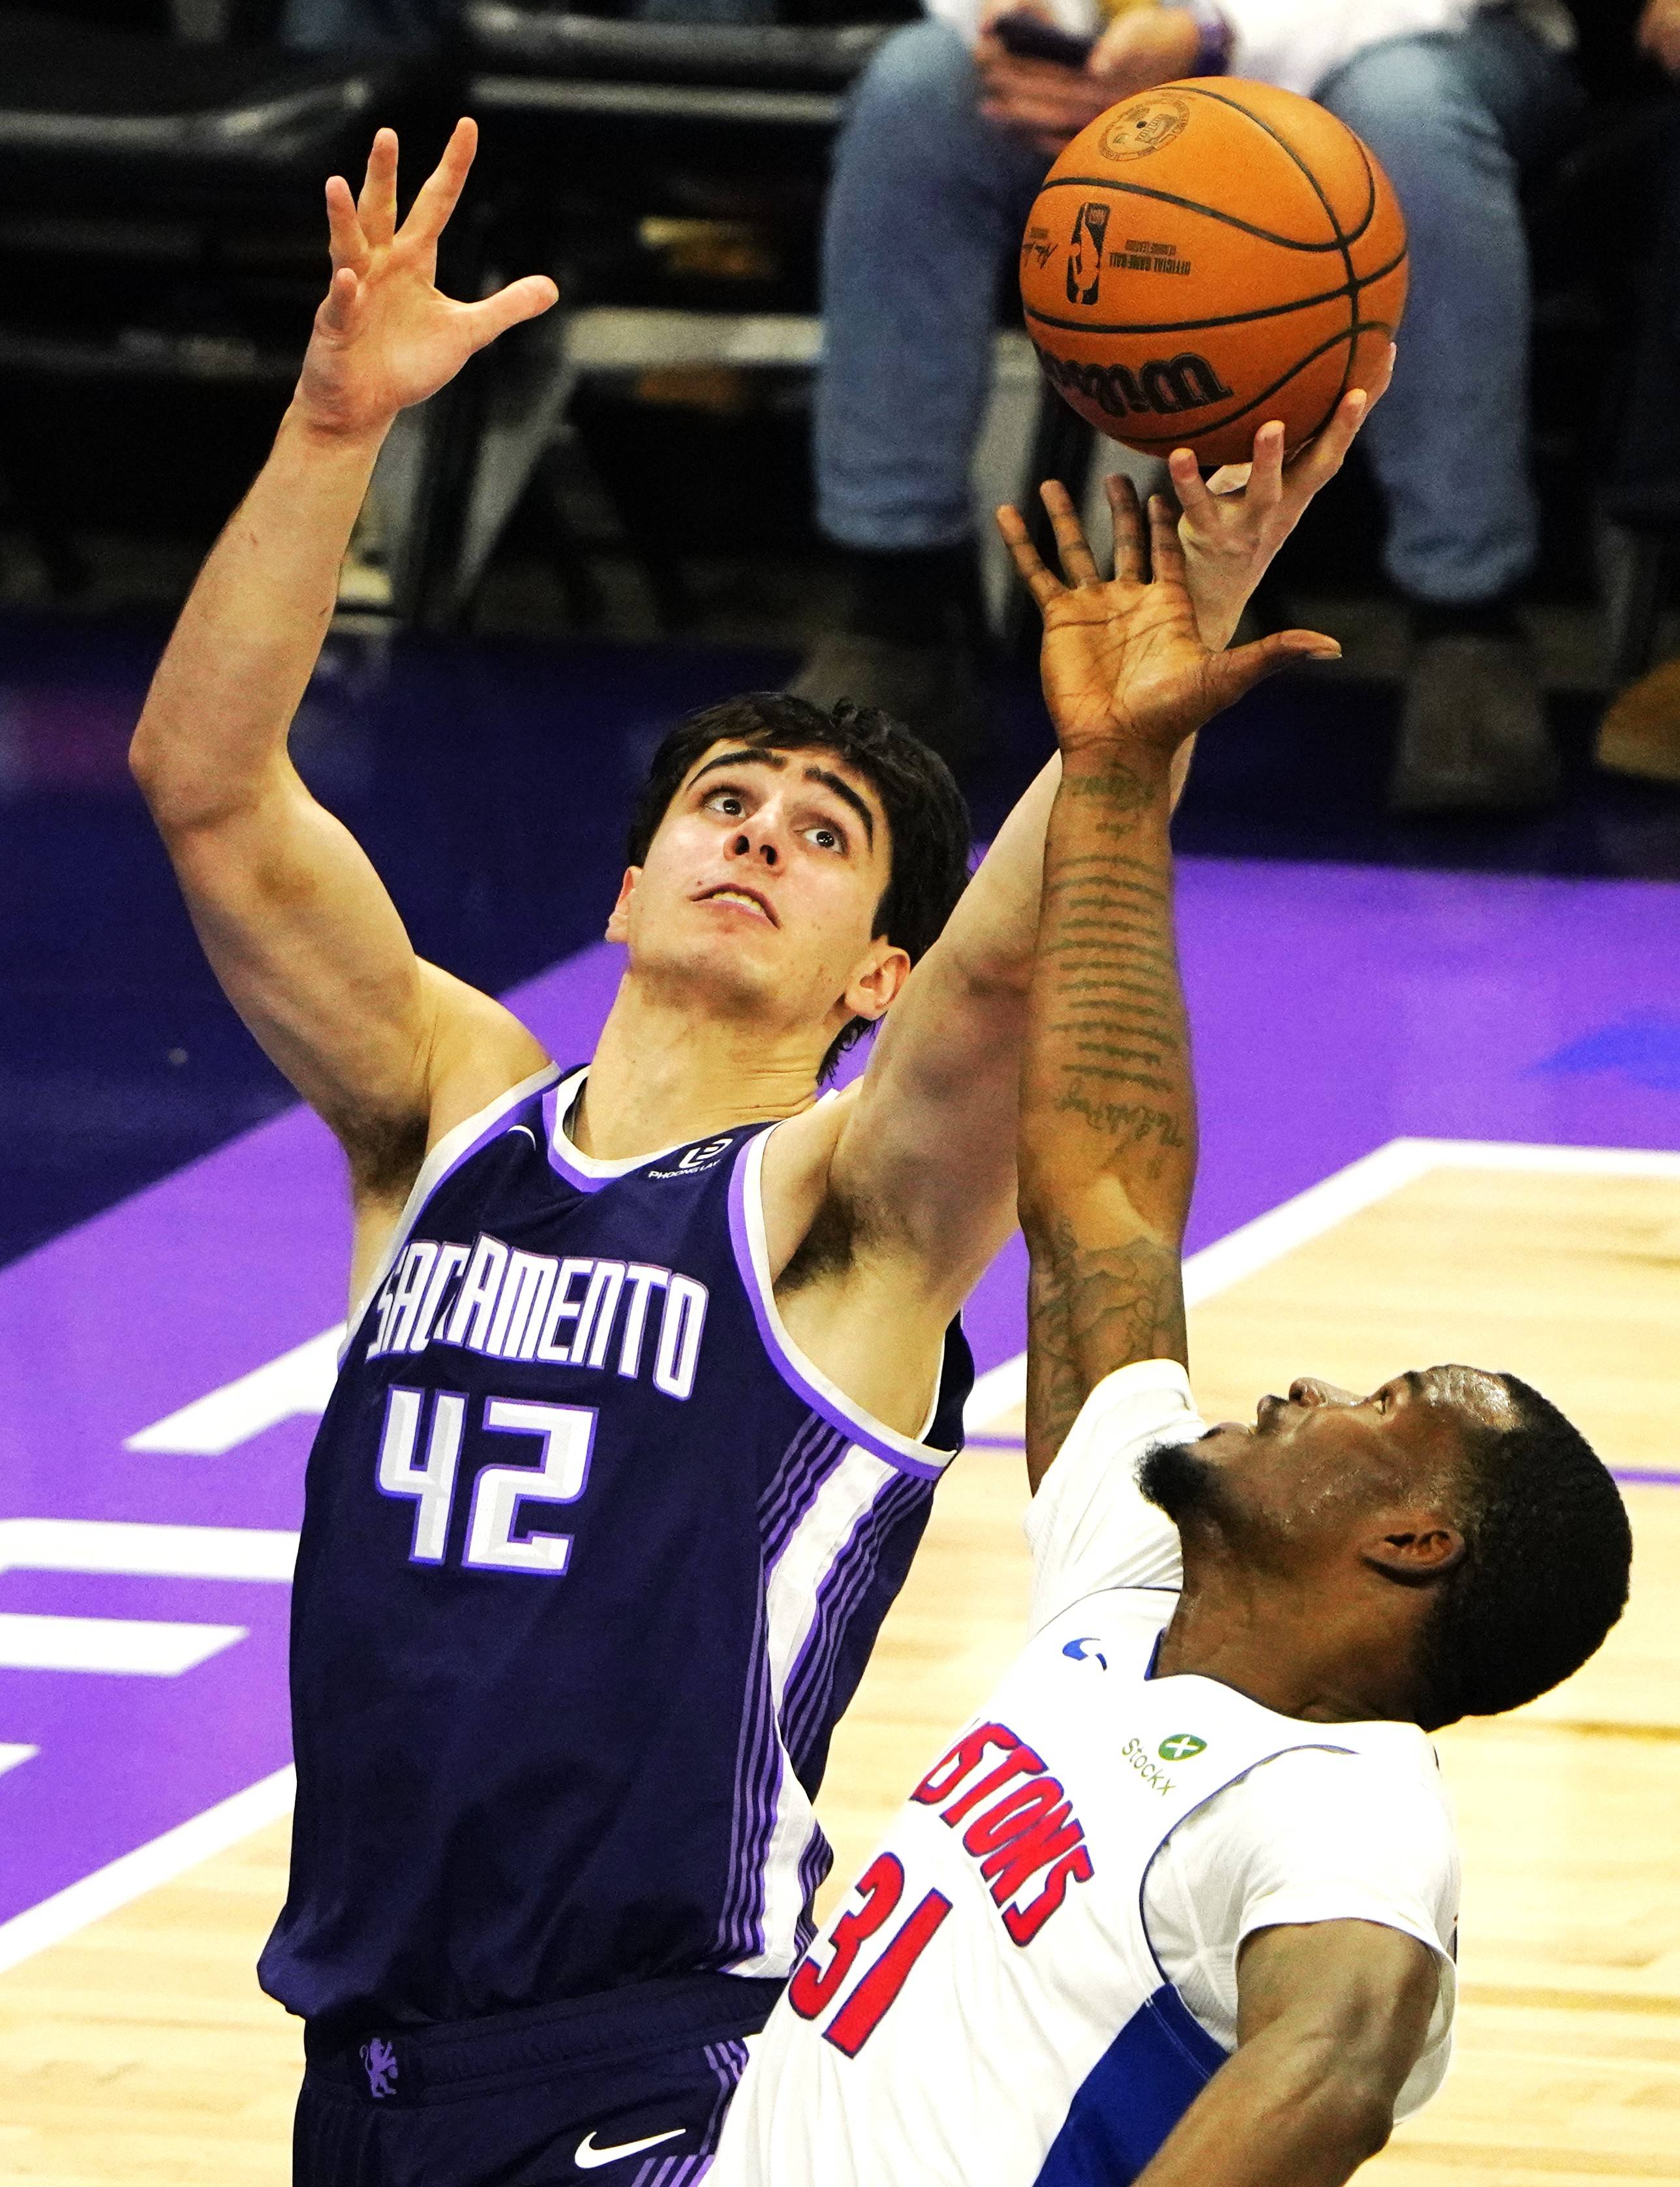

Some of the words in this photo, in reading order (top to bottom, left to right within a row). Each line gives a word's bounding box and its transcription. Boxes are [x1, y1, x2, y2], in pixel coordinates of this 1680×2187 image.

[1041, 352, 1233, 418] Wilso
[648, 1167, 701, 1180] PHOONG
[365, 1231, 709, 1401] SACAMENTO
[375, 1384, 600, 1577] 42
[908, 1721, 1095, 1948] STONS
[788, 1851, 953, 2060] 31
